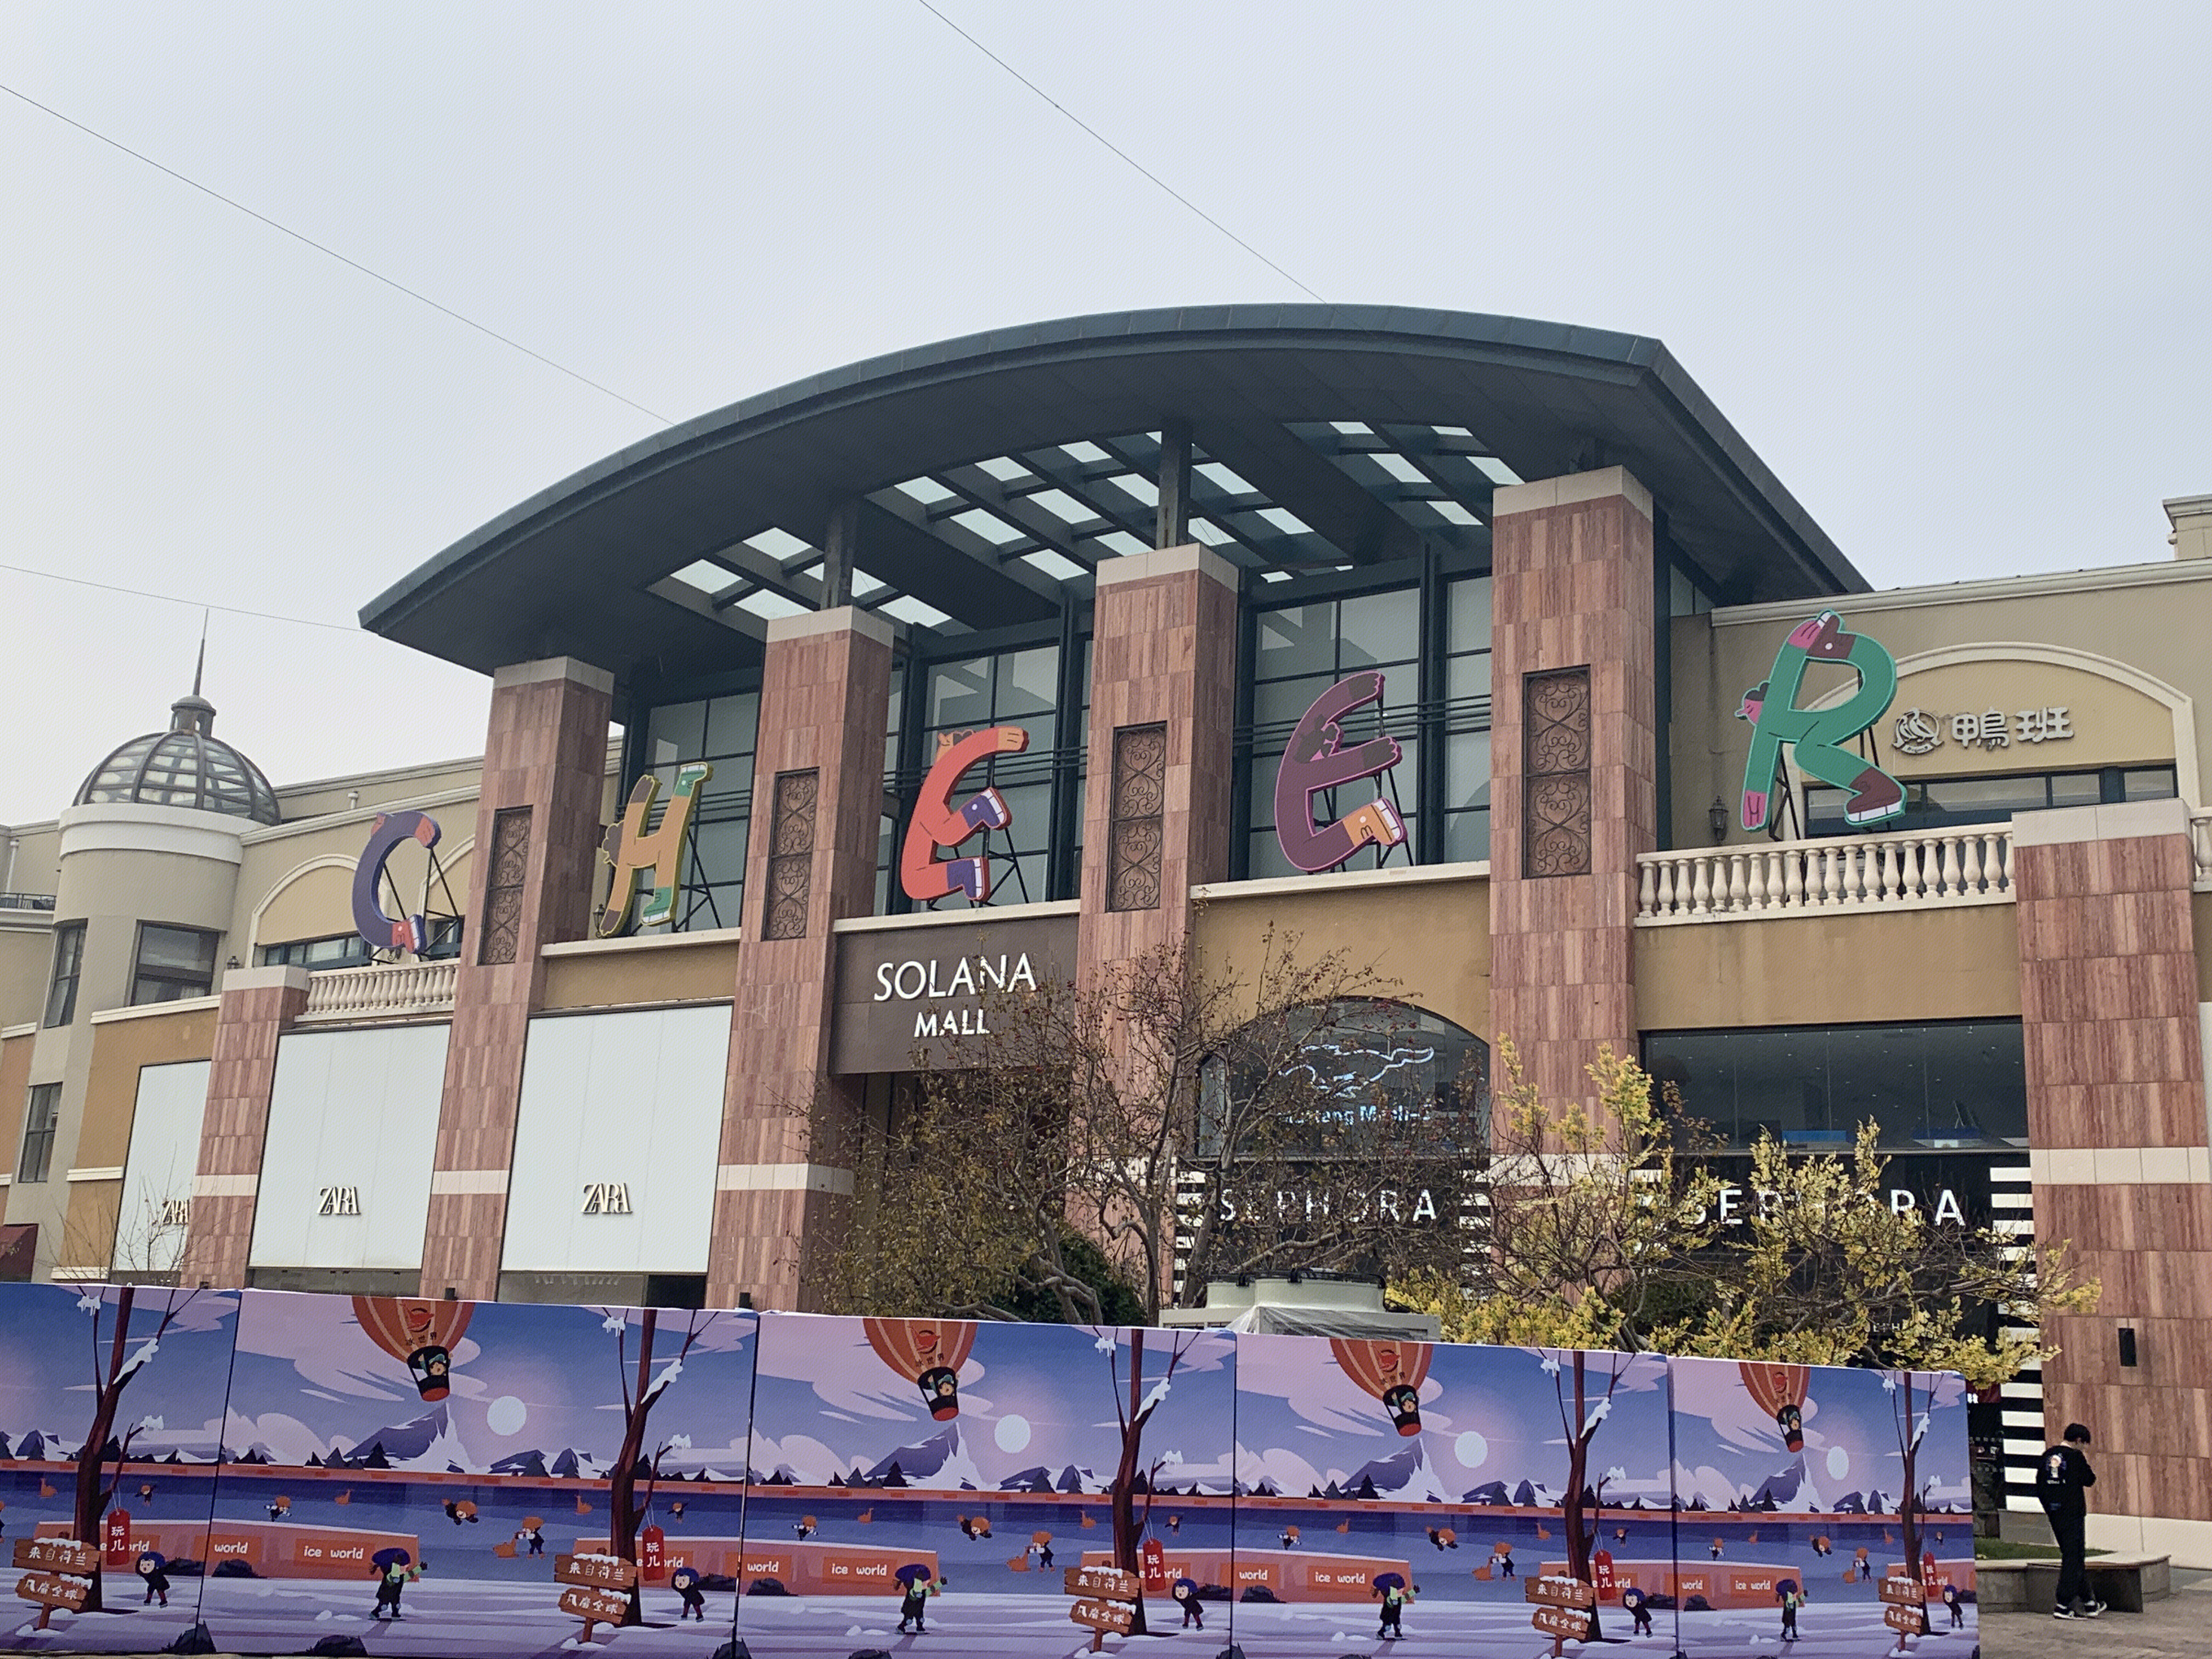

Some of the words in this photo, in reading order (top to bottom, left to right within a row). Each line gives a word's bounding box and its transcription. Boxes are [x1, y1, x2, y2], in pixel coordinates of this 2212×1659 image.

[874, 952, 1038, 1001] SOLANA
[914, 1009, 990, 1037] MALL
[317, 1187, 361, 1215] ZARA
[581, 1183, 633, 1214] ZARA
[162, 1200, 190, 1224] ZARA
[111, 1526, 125, 1552] 玩儿
[214, 1542, 249, 1554] world
[29, 1546, 86, 1566] 来自荷兰
[304, 1545, 322, 1557] ice
[330, 1547, 364, 1559] world
[646, 1542, 660, 1567] 玩儿
[569, 1561, 624, 1581] 来自荷兰
[747, 1561, 779, 1573] world
[832, 1564, 848, 1575] ice
[856, 1564, 887, 1576] world
[1239, 1569, 1268, 1581] world
[1315, 1572, 1330, 1583] ice
[1337, 1573, 1365, 1584] world
[1681, 1580, 1703, 1590] world
[1735, 1580, 1747, 1590] ice
[1751, 1580, 1770, 1590] world
